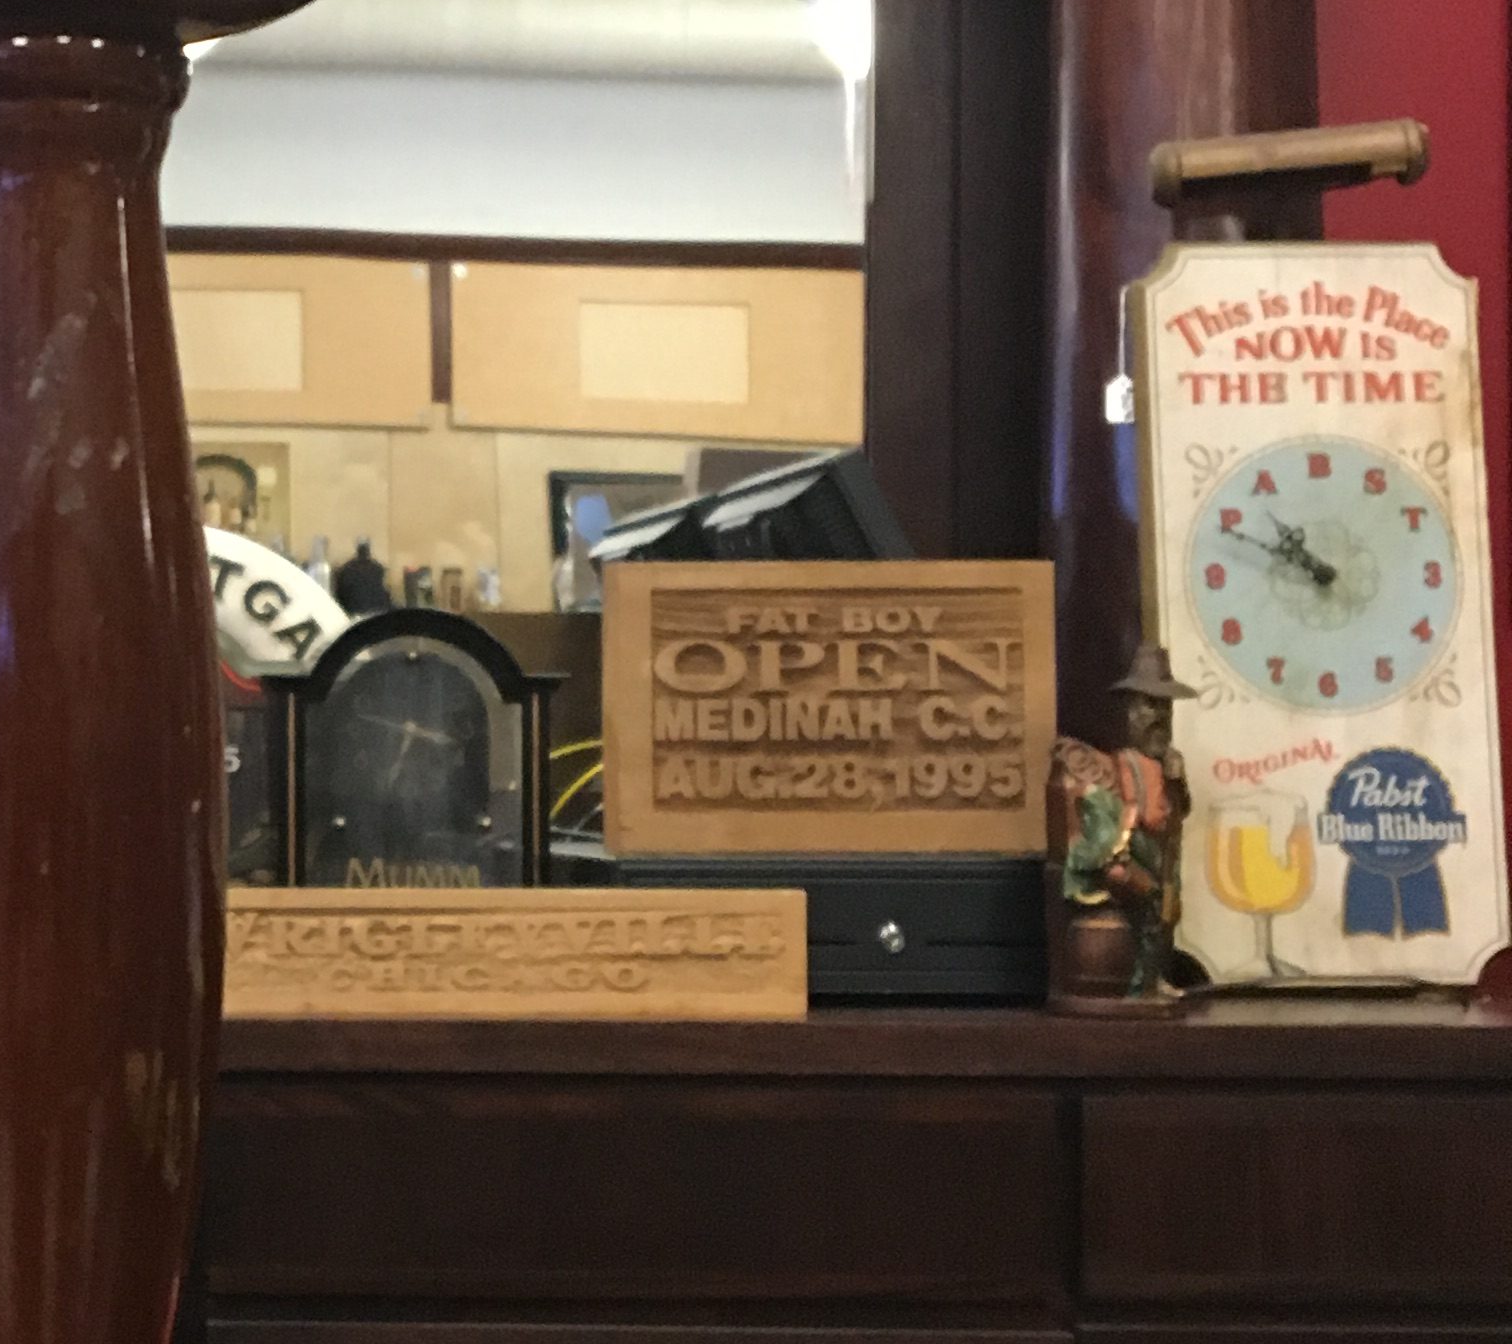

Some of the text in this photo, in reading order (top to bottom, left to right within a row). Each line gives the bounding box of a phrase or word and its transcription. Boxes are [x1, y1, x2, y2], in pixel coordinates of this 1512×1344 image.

[1165, 280, 1450, 357] This is the Place
[1235, 325, 1397, 361] NOW IS
[1179, 369, 1445, 405] THE TIME
[727, 606, 943, 634] FAT BOY
[653, 638, 1023, 693] OPEN
[655, 695, 1023, 741] MEDINAH C.C.
[1213, 736, 1339, 785] ORIGINAL
[1347, 765, 1430, 809] Pabst
[1320, 812, 1465, 845] Blue Ribbon
